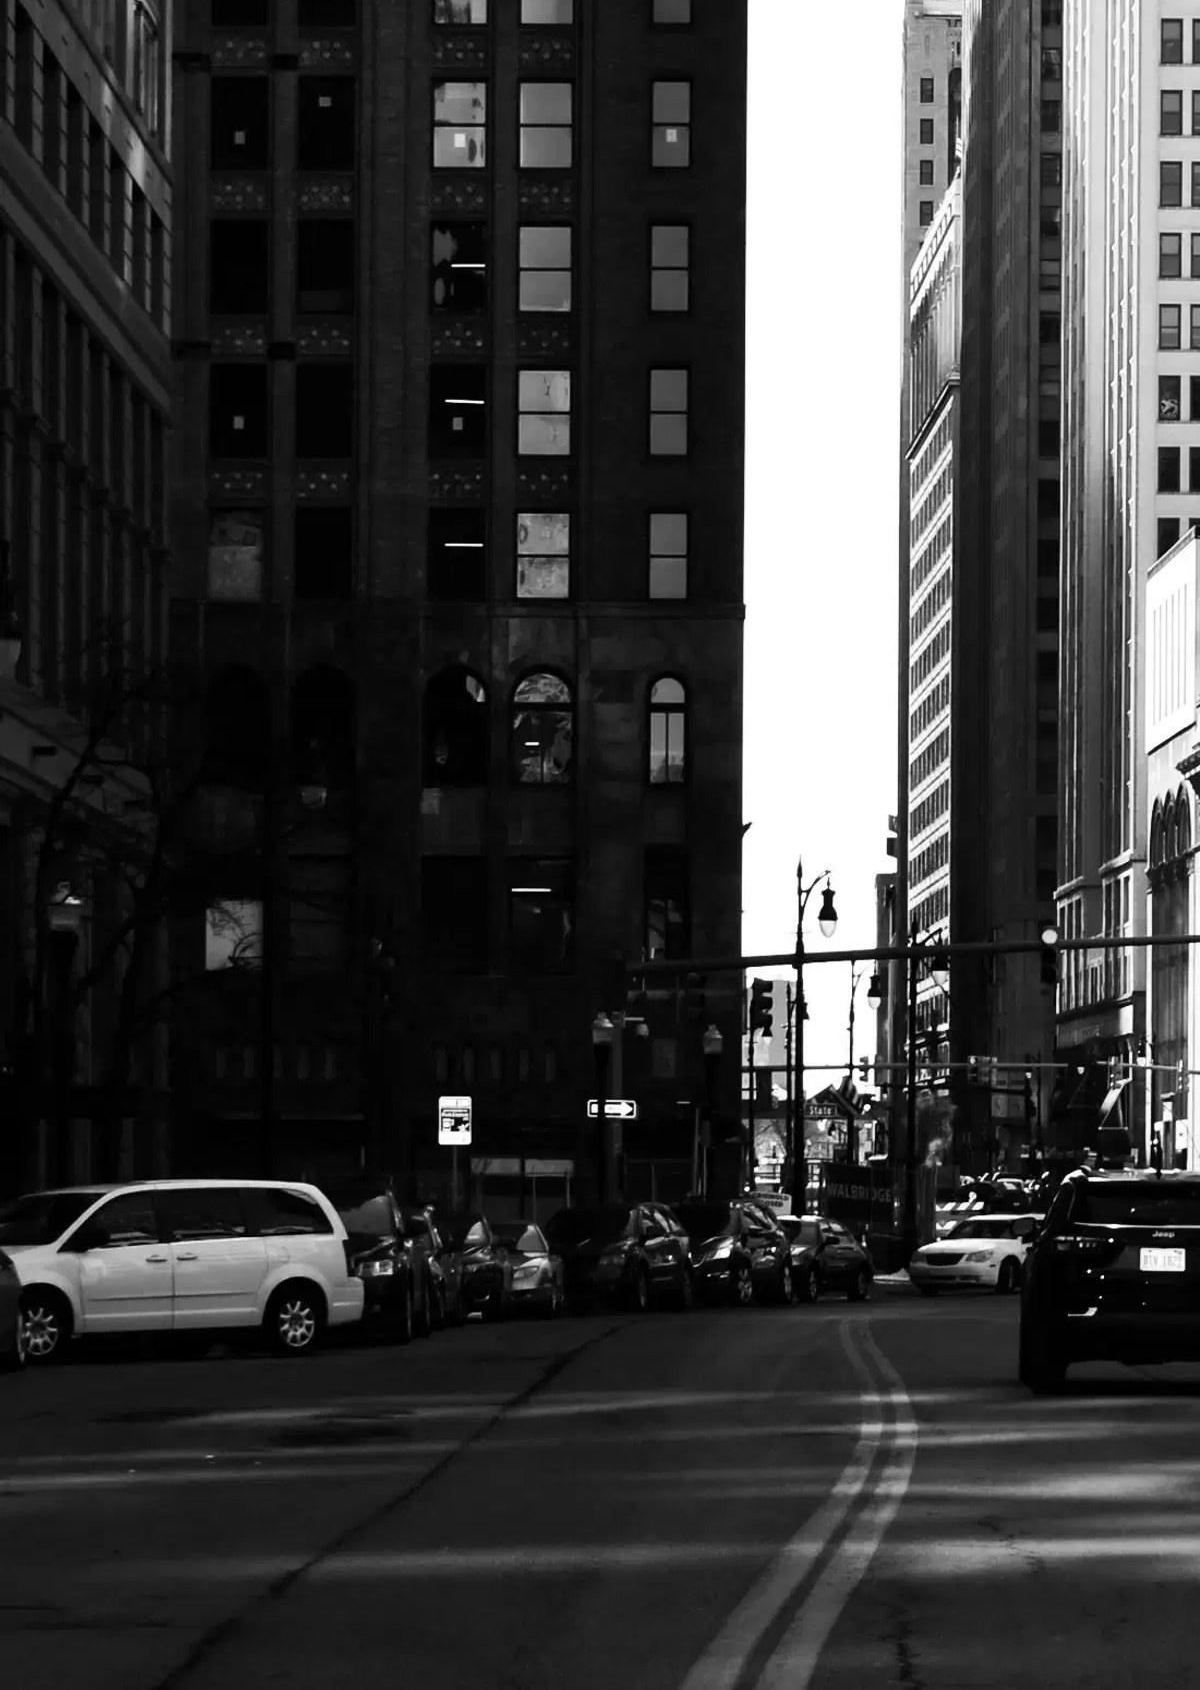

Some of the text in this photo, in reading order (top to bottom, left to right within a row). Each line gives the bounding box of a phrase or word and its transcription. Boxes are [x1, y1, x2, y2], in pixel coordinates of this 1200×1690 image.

[809, 1106, 832, 1115] State
[826, 1182, 893, 1203] WALBRIDGE
[1152, 1230, 1175, 1238] Jeep
